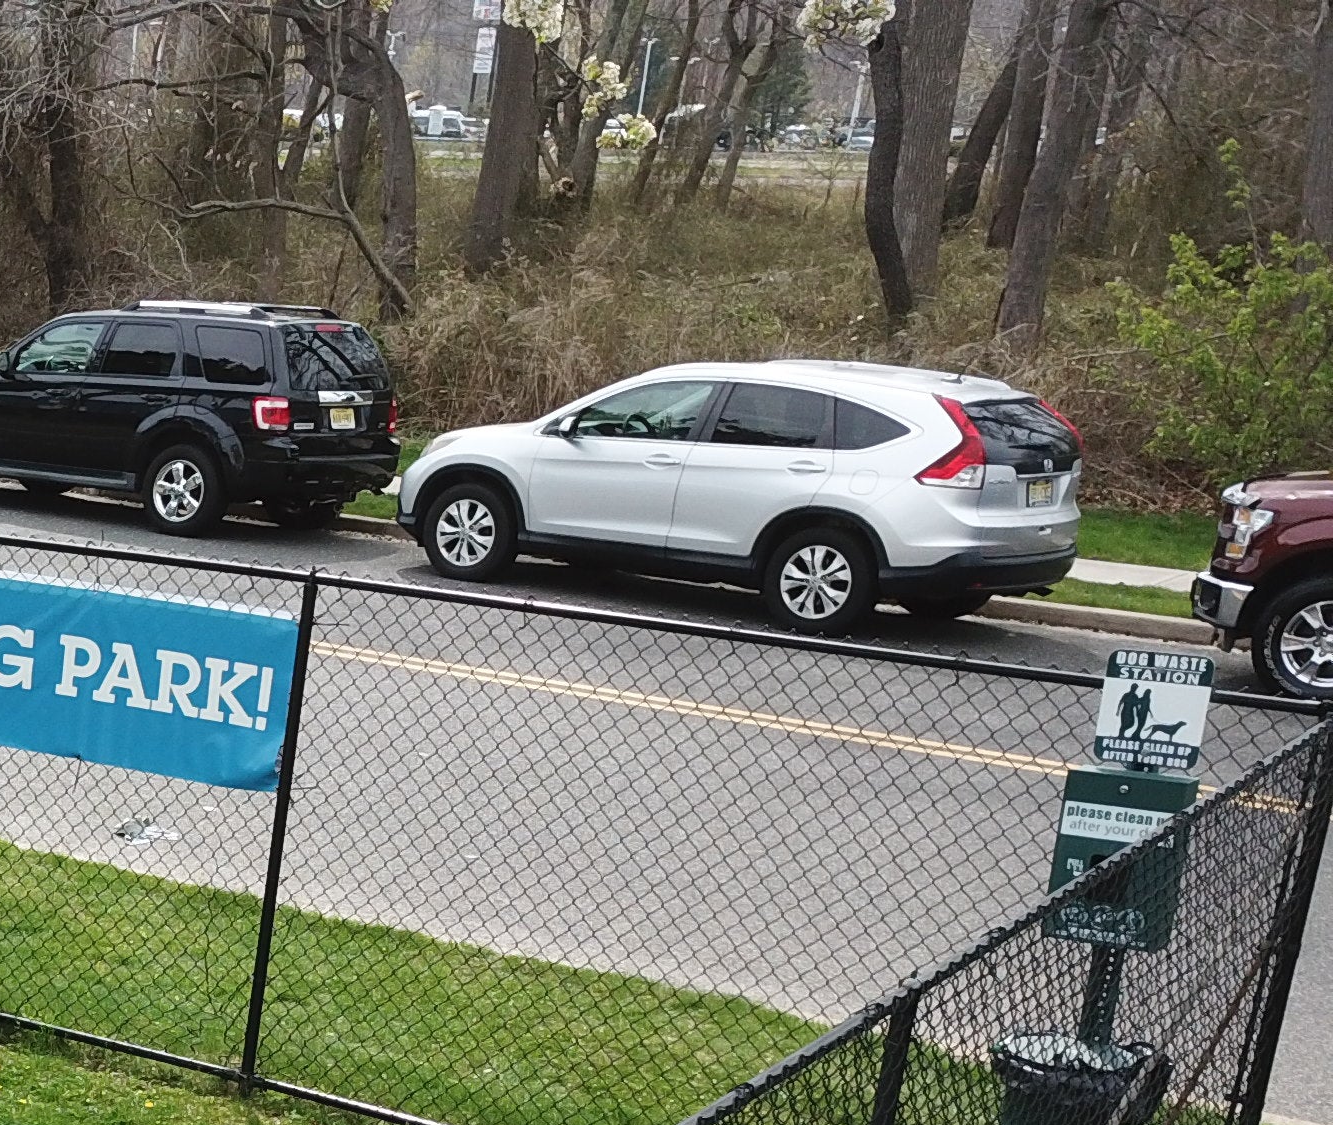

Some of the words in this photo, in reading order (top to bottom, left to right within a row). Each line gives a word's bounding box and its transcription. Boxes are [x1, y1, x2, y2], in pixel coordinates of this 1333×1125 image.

[1115, 651, 1149, 666] DOG
[1154, 654, 1208, 672] WASTE
[54, 633, 274, 731] PARK!
[1119, 667, 1201, 685] STATION
[1102, 738, 1140, 751] PLEASE
[1143, 742, 1175, 754] CLEAN
[1177, 746, 1192, 756] UP
[1102, 750, 1134, 762] AFTER
[1066, 805, 1112, 821] please
[1115, 811, 1153, 826] clean
[1069, 819, 1101, 832] after
[1104, 823, 1136, 837] your
